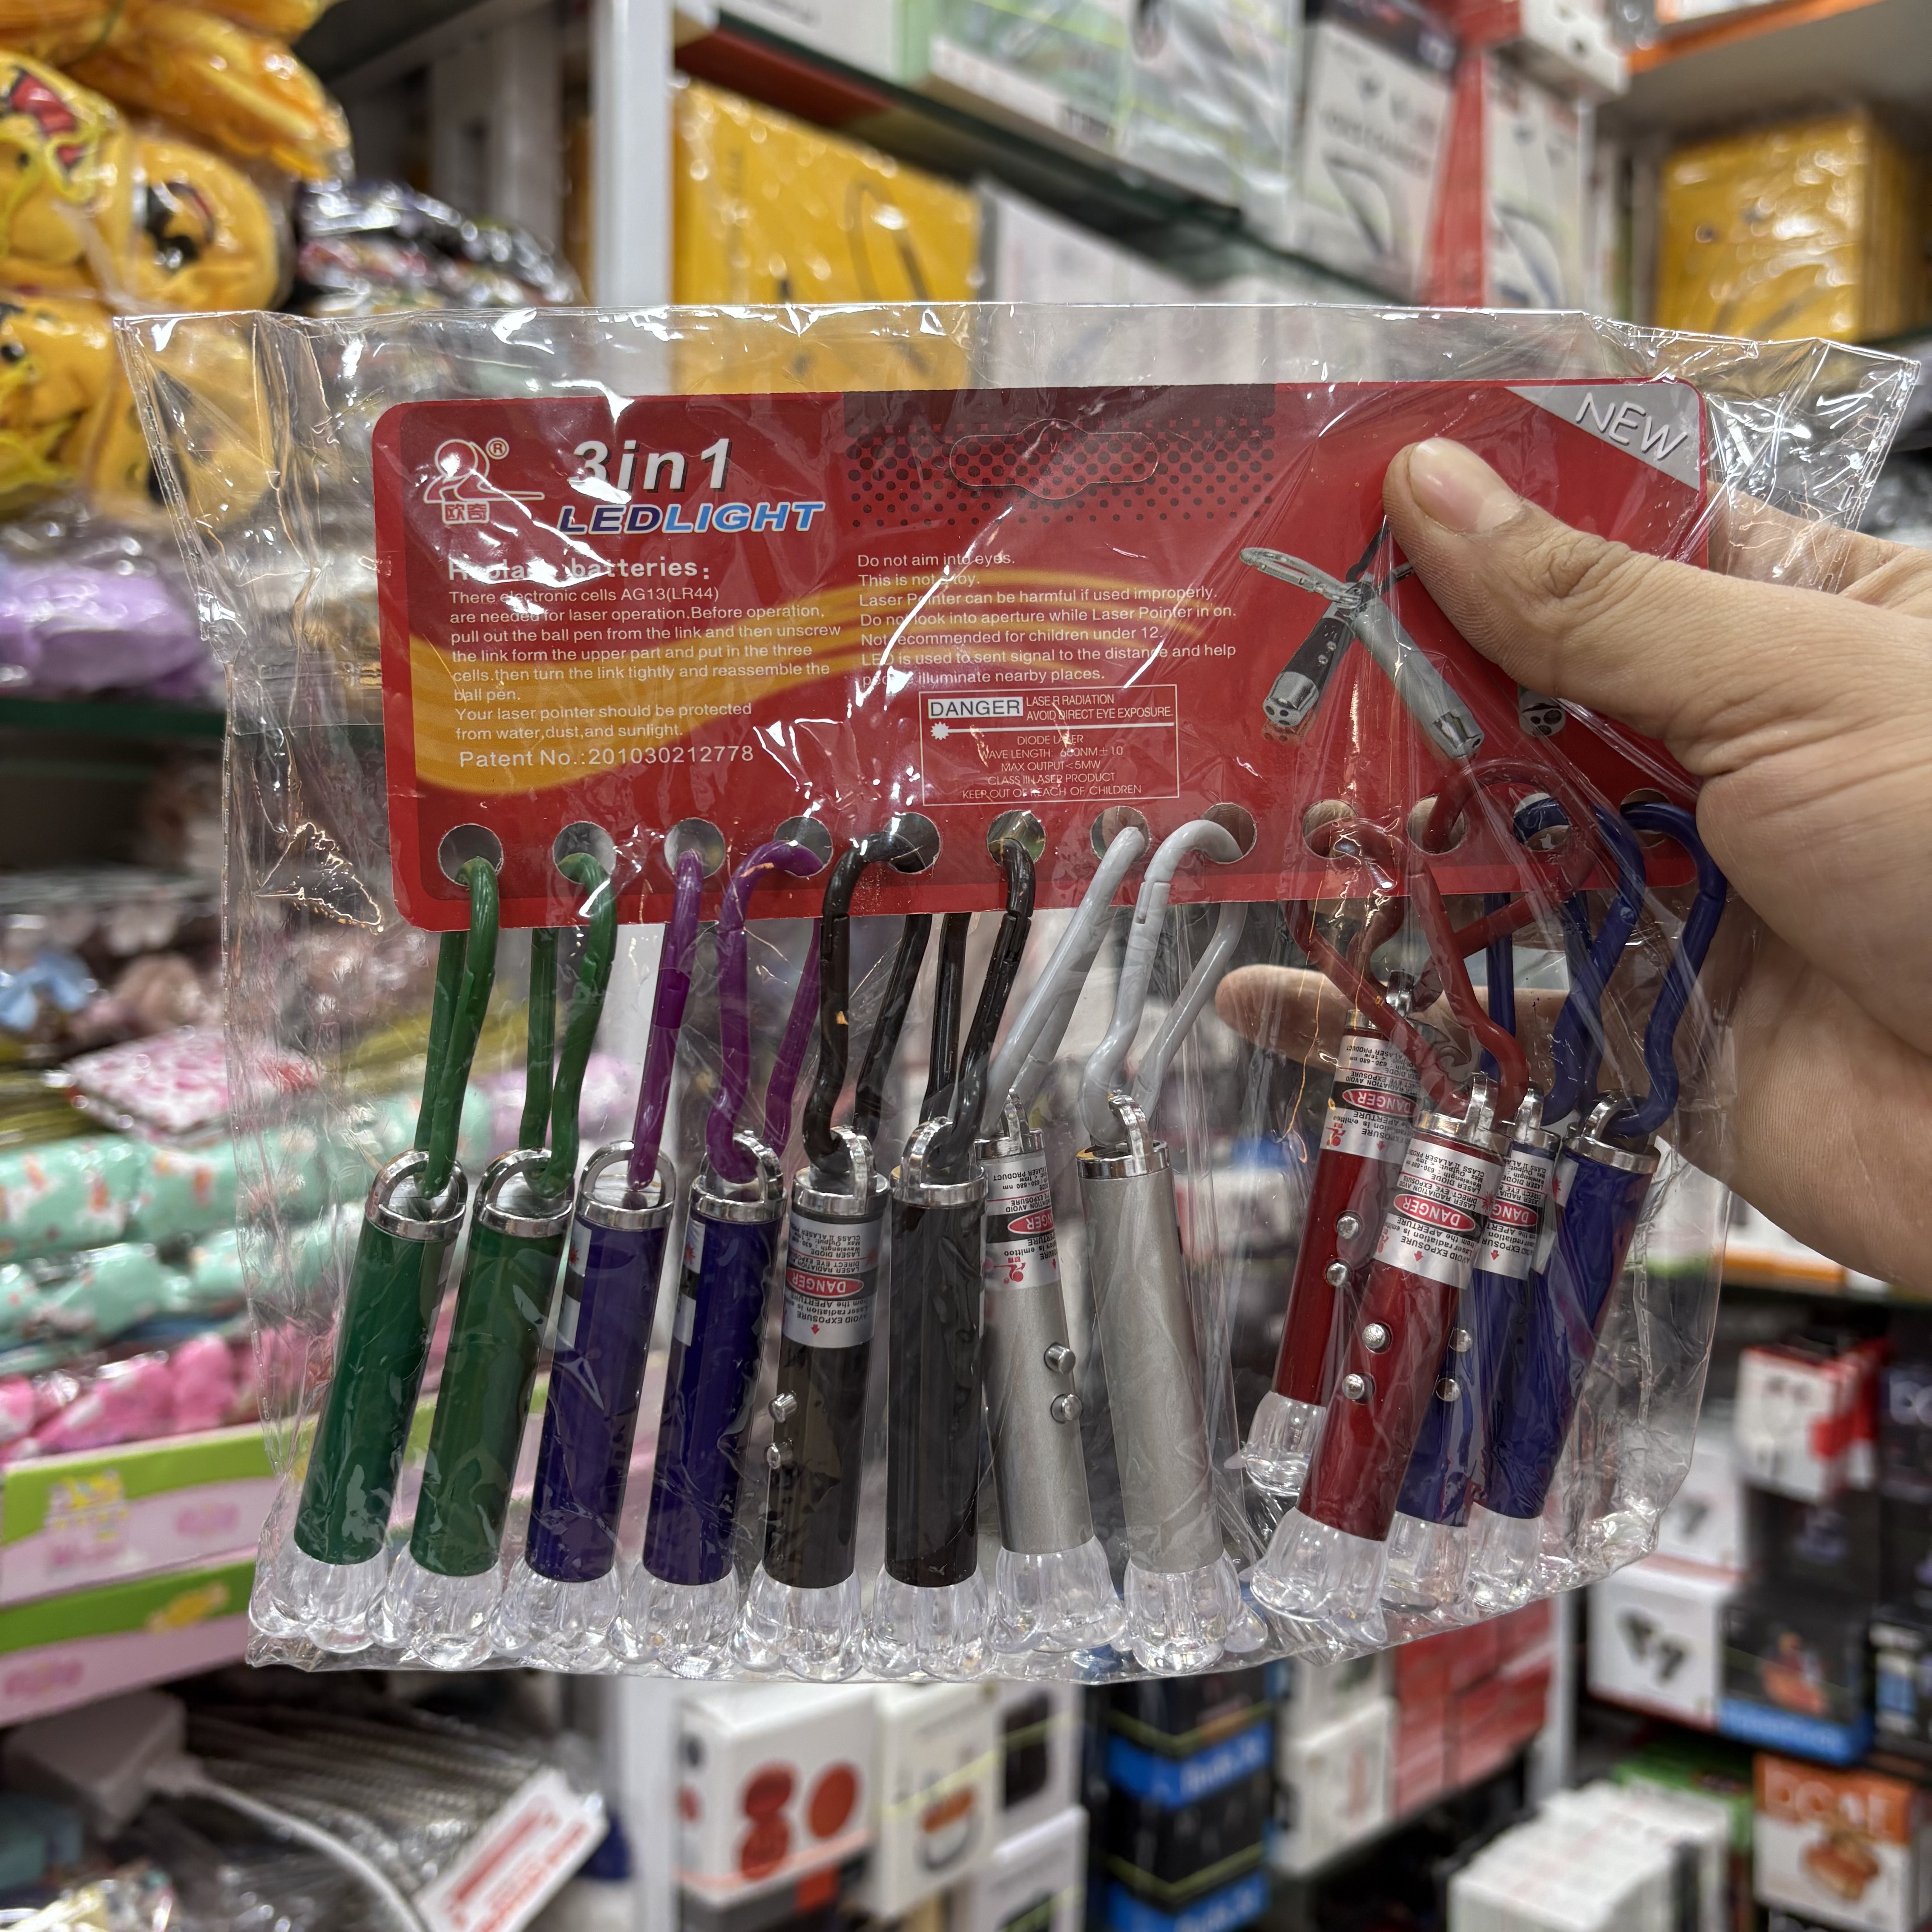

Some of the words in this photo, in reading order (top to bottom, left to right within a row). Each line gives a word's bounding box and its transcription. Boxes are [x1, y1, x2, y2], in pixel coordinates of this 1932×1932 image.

[1576, 392, 1688, 460] NEW
[571, 437, 731, 494] 3in1
[557, 502, 825, 534] LEDLIGHT
[571, 557, 709, 580] batteries:
[858, 555, 879, 567] Do
[883, 554, 907, 566] not
[911, 553, 939, 566] aim
[943, 553, 970, 565] into
[858, 574, 891, 587] This
[895, 574, 907, 585] is
[912, 574, 935, 585] not
[449, 592, 495, 604] There
[581, 589, 616, 602] cells
[621, 587, 719, 602] AG13(LR44)
[859, 594, 902, 606] Laser
[965, 594, 992, 604] can
[997, 591, 1015, 603] be
[1020, 590, 1076, 603] harmful
[1081, 589, 1089, 601] if
[1093, 588, 1130, 600] used
[1134, 585, 1217, 602] improperly.
[450, 613, 475, 623] are
[481, 610, 539, 622] needed
[544, 609, 565, 621] for
[569, 609, 607, 621] laser
[860, 614, 882, 626] Do
[886, 614, 908, 625] no
[915, 612, 946, 625] look
[950, 612, 977, 624] into
[981, 612, 1045, 627] aperture
[1049, 609, 1087, 621] while
[1092, 609, 1135, 621] Laser
[1139, 607, 1192, 619] Pointer
[1213, 607, 1236, 617] on.
[451, 630, 478, 645] pull
[483, 631, 509, 642] out
[513, 630, 537, 642] the
[542, 628, 569, 641] ball
[574, 630, 603, 643] pen
[607, 627, 642, 640] from
[646, 627, 671, 639] the
[675, 626, 701, 639] link
[705, 626, 734, 638] and
[738, 625, 772, 638] then
[777, 625, 841, 637] unscrew
[861, 634, 887, 646] Not
[891, 631, 1000, 645] ecommended
[1005, 630, 1025, 643] for
[1029, 629, 1088, 642] children
[1093, 628, 1136, 639] under
[452, 650, 477, 662] the
[481, 649, 507, 662] link
[512, 649, 547, 662] form
[552, 648, 577, 661] the
[581, 649, 626, 663] upper
[630, 646, 661, 662] part
[665, 646, 694, 658] and
[699, 646, 722, 661] put
[727, 645, 740, 658] in
[744, 645, 768, 657] the
[773, 644, 812, 657] three
[862, 653, 894, 666] LED
[899, 652, 911, 664] is
[915, 652, 952, 664] used
[956, 653, 970, 664] to
[974, 651, 1006, 663] sent
[1011, 649, 1055, 665] signal
[1059, 649, 1073, 661] to
[1077, 648, 1100, 660] the
[1173, 645, 1200, 657] and
[1204, 644, 1236, 659] help
[533, 669, 564, 680] turn
[568, 667, 593, 680] the
[598, 667, 624, 679] link
[628, 665, 675, 681] tightly
[679, 665, 708, 677] and
[713, 663, 802, 677] reassemble
[805, 662, 830, 675] the
[918, 671, 991, 685] illuminate
[995, 669, 1047, 684] nearby
[1051, 668, 1104, 683] places.
[454, 688, 482, 701] ball
[487, 690, 520, 704] pen.
[1062, 694, 1114, 705] RADIATION
[455, 708, 492, 721] Your
[497, 708, 536, 720] laser
[541, 706, 595, 721] pointer
[599, 705, 651, 718] should
[655, 704, 674, 716] be
[679, 702, 752, 718] protected
[930, 699, 1020, 716] DANGER
[1026, 710, 1056, 721] AVOID
[1058, 709, 1094, 720] DIRECT
[1096, 708, 1116, 718] EYE
[456, 727, 491, 740] from
[618, 723, 683, 739] sunlight.
[1017, 736, 1050, 745] DIODE
[460, 750, 533, 768] Patent
[982, 749, 1008, 759] WAVE
[1002, 763, 1025, 771] MAX
[988, 776, 1020, 785] CLASS
[1066, 773, 1115, 782] PRODUCT
[990, 789, 1010, 798] OUT
[1070, 786, 1085, 796] OF
[1090, 785, 1141, 795] CHILDREN
[1357, 1092, 1411, 1113] DANGER
[1353, 1111, 1399, 1126] APERTURE
[993, 1172, 1026, 1181] PRODUCT
[1006, 1204, 1026, 1212] AVOID
[1402, 1197, 1461, 1226] DANGER
[1397, 1218, 1443, 1237] APERTURE
[1400, 1236, 1448, 1257] EXPOSURE
[1413, 1232, 1452, 1249] radiation
[792, 1272, 846, 1293] DANGER
[797, 1311, 842, 1324] EXPOSURE
